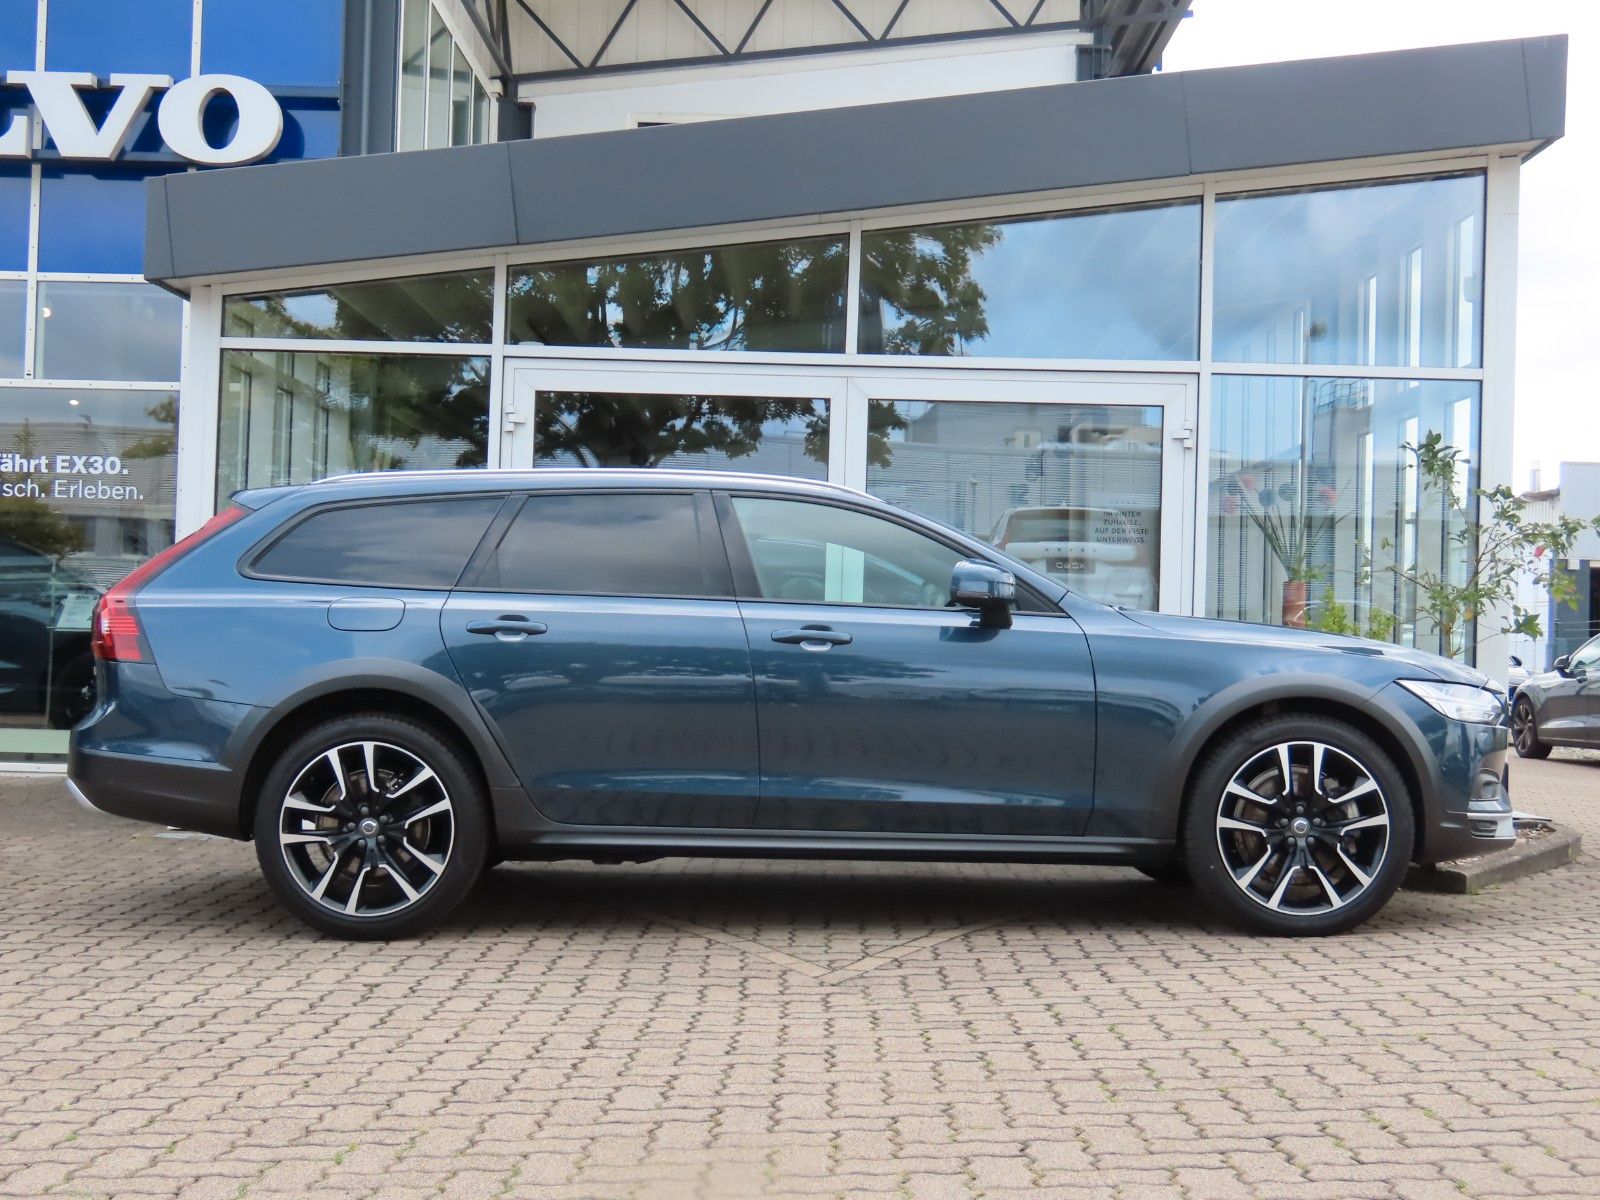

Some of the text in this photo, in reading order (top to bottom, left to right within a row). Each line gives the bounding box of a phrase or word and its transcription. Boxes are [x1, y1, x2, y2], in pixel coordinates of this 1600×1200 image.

[0, 453, 129, 475] ährt EX30.
[54, 480, 144, 500] Erleben.
